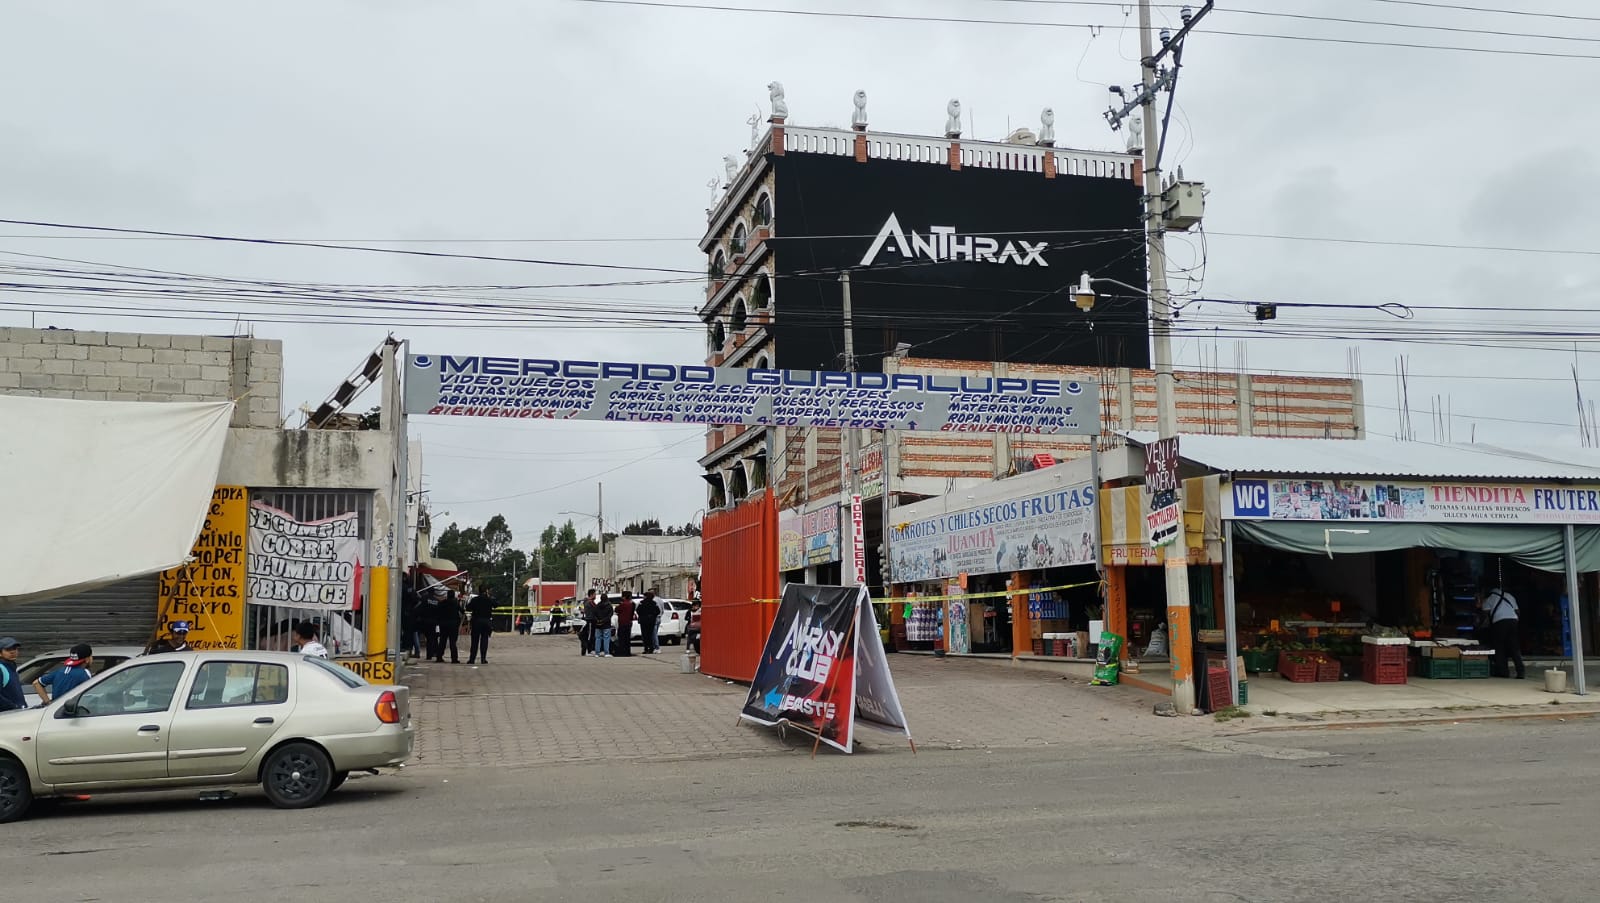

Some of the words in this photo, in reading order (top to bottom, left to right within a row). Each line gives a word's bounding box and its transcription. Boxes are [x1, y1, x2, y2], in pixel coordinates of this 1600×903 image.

[859, 211, 1049, 267] ANTHRAX
[440, 355, 715, 383] MERCADO
[747, 368, 1061, 396] GUADALUPE
[440, 374, 503, 386] VIDEO
[509, 377, 594, 389] JUEGOS
[439, 385, 507, 397] FRUTAS
[515, 388, 597, 400] VERDURAS
[621, 380, 662, 391] LES
[673, 383, 795, 396] OFRECEMOS
[800, 388, 811, 396] A
[815, 389, 892, 400] USTEDES
[438, 396, 520, 408] ABARROTES
[532, 398, 592, 410] COMIDAS
[609, 391, 665, 402] CARNES
[674, 393, 760, 405] CHICHARRON
[772, 396, 821, 408] QUESOS
[828, 400, 836, 408] Y
[839, 400, 924, 411] REFRESCOS
[949, 393, 1047, 404] TECATEANDO
[428, 406, 556, 419] BIENVENIDOS
[609, 402, 681, 413] TORTILLAS
[693, 405, 754, 415] BOTANAS
[772, 407, 831, 418] MADERA
[838, 410, 845, 418] Y
[851, 410, 908, 420] CARBON
[948, 402, 1018, 414] MATERIAS
[1021, 405, 1073, 416] PRIMAS
[605, 412, 674, 423] ALTURA
[683, 414, 743, 424] MAXIMA
[948, 413, 981, 424] ROPA
[985, 416, 992, 424] Y
[993, 415, 1034, 426] MUCHO
[1037, 417, 1078, 428] MAS...
[940, 422, 1042, 434] BIENVENIDOS
[1145, 439, 1178, 464] VENTA
[1156, 460, 1167, 472] DE
[1145, 469, 1178, 493] MADERA
[1235, 484, 1265, 510] WC
[1431, 486, 1526, 504] TIENDITA
[890, 520, 937, 543] ABARROTES
[940, 518, 946, 533] Y
[948, 510, 981, 531] CHILES
[983, 502, 1017, 524] SECOS
[1021, 486, 1095, 518] FRUTAS
[1147, 504, 1179, 529] TORTILLERIA
[852, 495, 865, 582] TORTILLERIA
[947, 527, 996, 554] JUANITA
[262, 534, 338, 561] COBRE,
[1110, 548, 1158, 558] FRUTERIA
[247, 553, 354, 582] ALUMINIO
[258, 578, 349, 604] BRONCE
